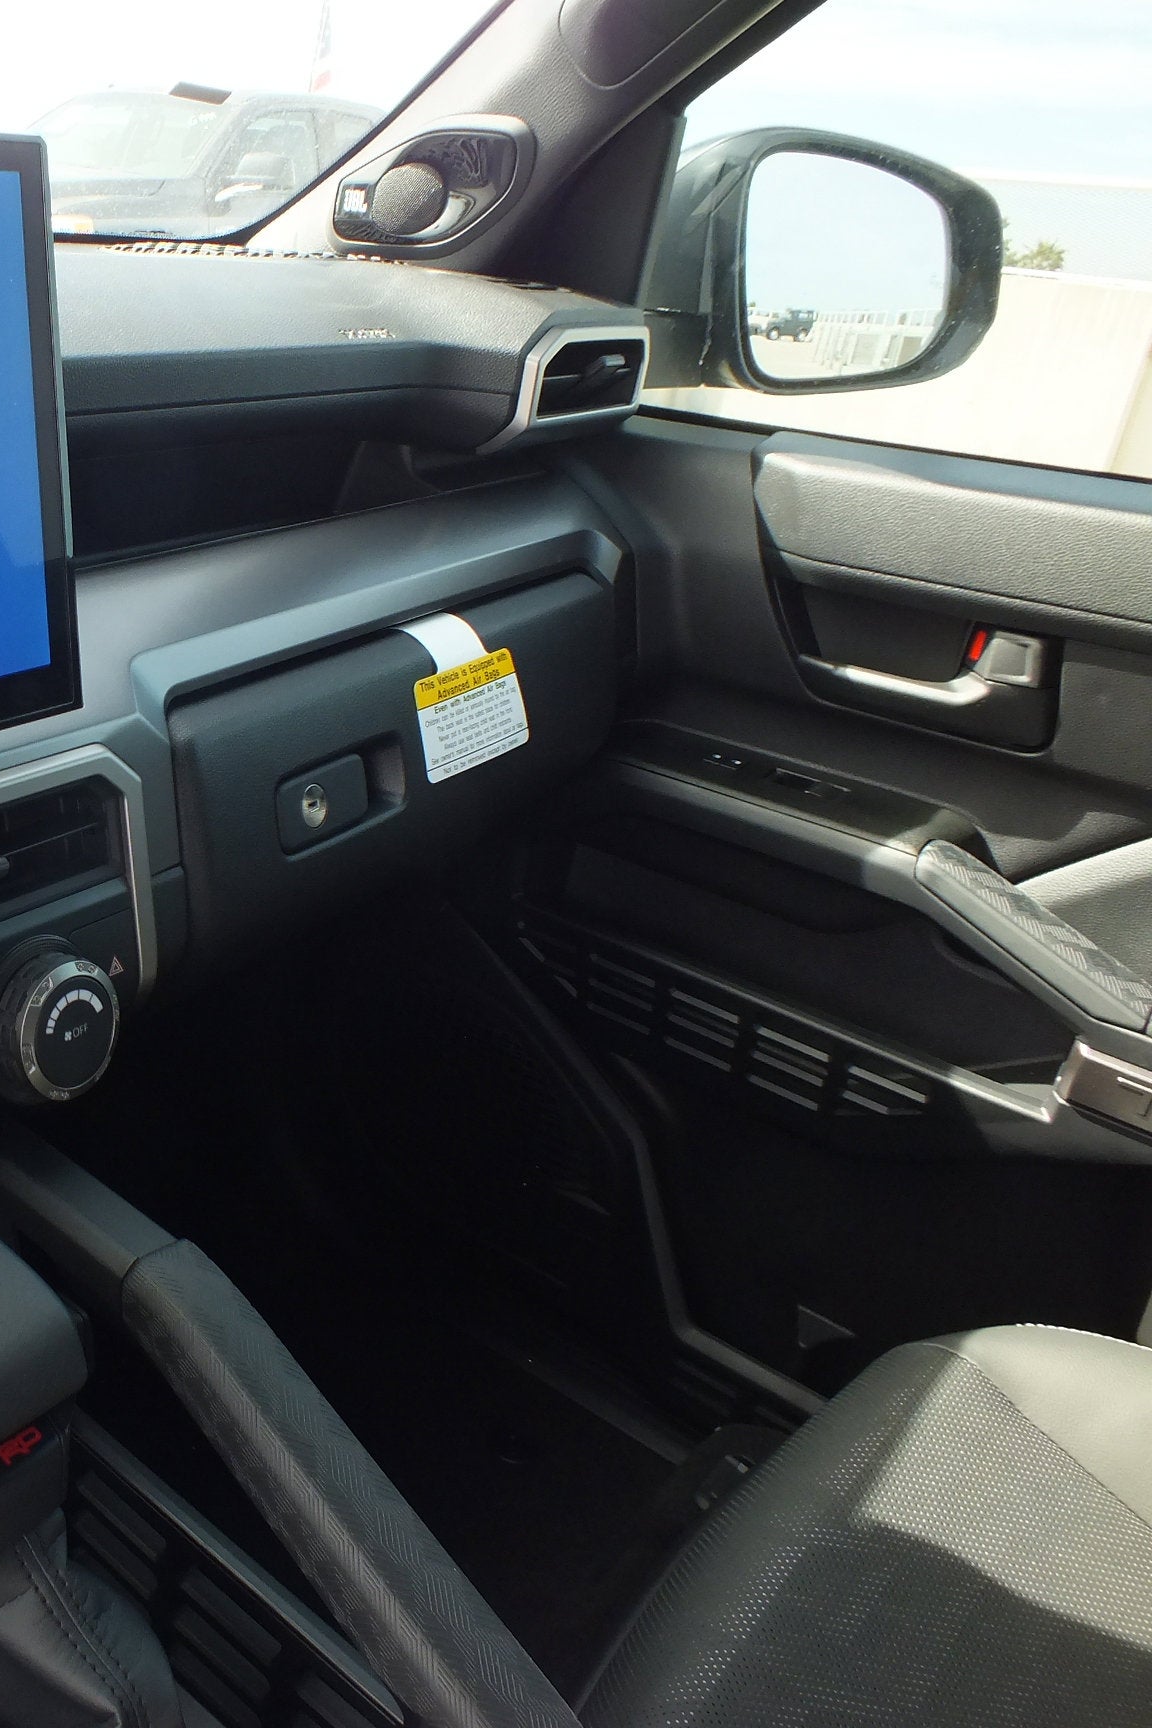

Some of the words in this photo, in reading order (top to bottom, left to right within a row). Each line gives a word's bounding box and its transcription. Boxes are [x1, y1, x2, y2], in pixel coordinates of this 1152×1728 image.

[419, 681, 435, 693] This
[437, 671, 459, 686] Vehicle
[460, 667, 468, 677] is
[469, 656, 495, 674] Equipped
[496, 651, 508, 662] with
[438, 680, 470, 700] Advanced
[473, 675, 482, 686] Air
[484, 669, 500, 681] Bags
[72, 1022, 89, 1039] OFF
